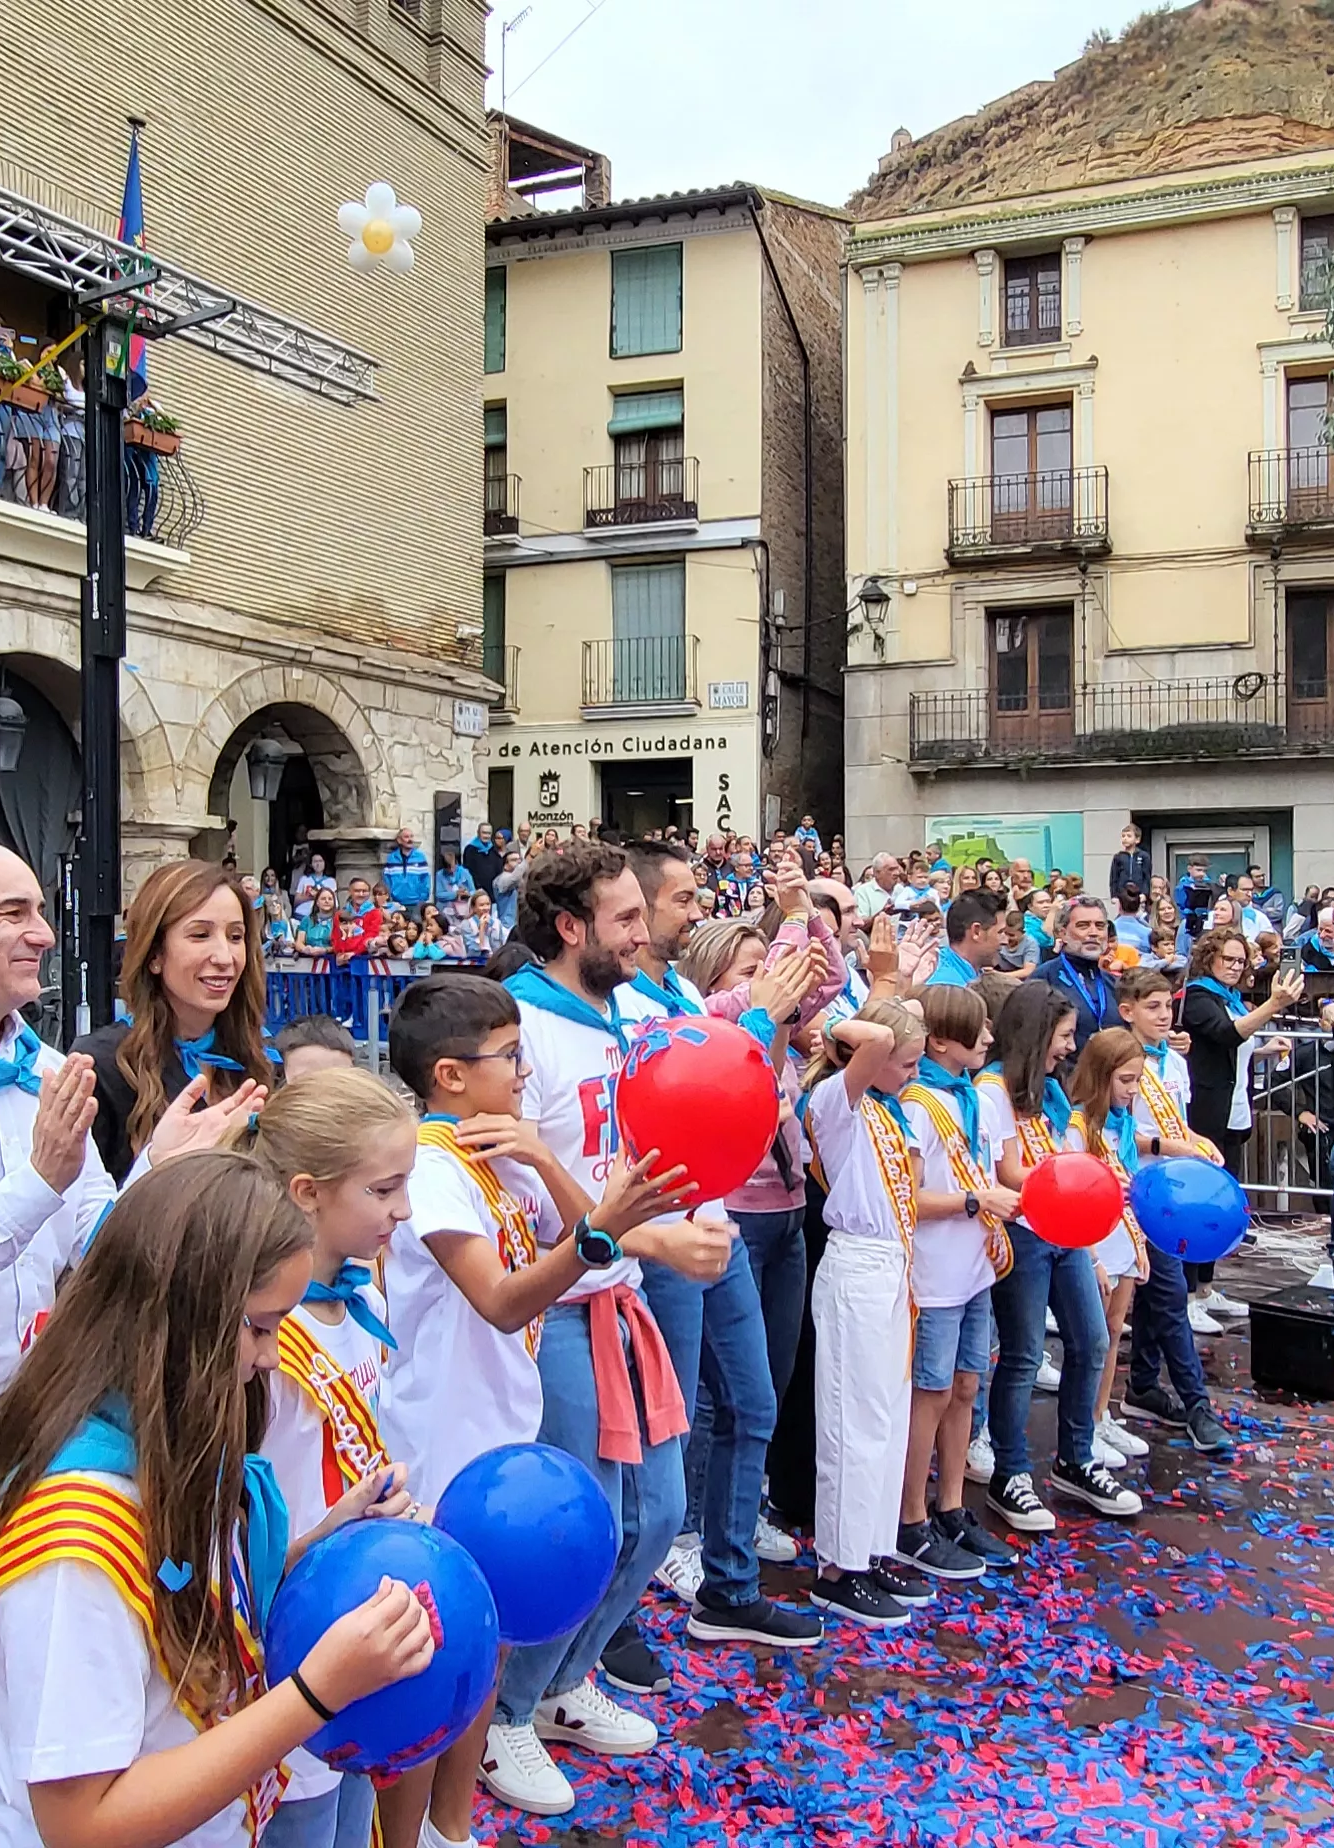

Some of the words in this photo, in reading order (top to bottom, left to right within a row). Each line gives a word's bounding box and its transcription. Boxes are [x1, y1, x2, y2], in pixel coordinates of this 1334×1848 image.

[722, 686, 744, 694] CALLE
[714, 696, 744, 705] MAYOR
[498, 742, 521, 757] de
[529, 738, 614, 757] Atención
[622, 735, 728, 752] Ciudadana
[528, 810, 574, 821] Monzón
[309, 1352, 384, 1480] Zagal
